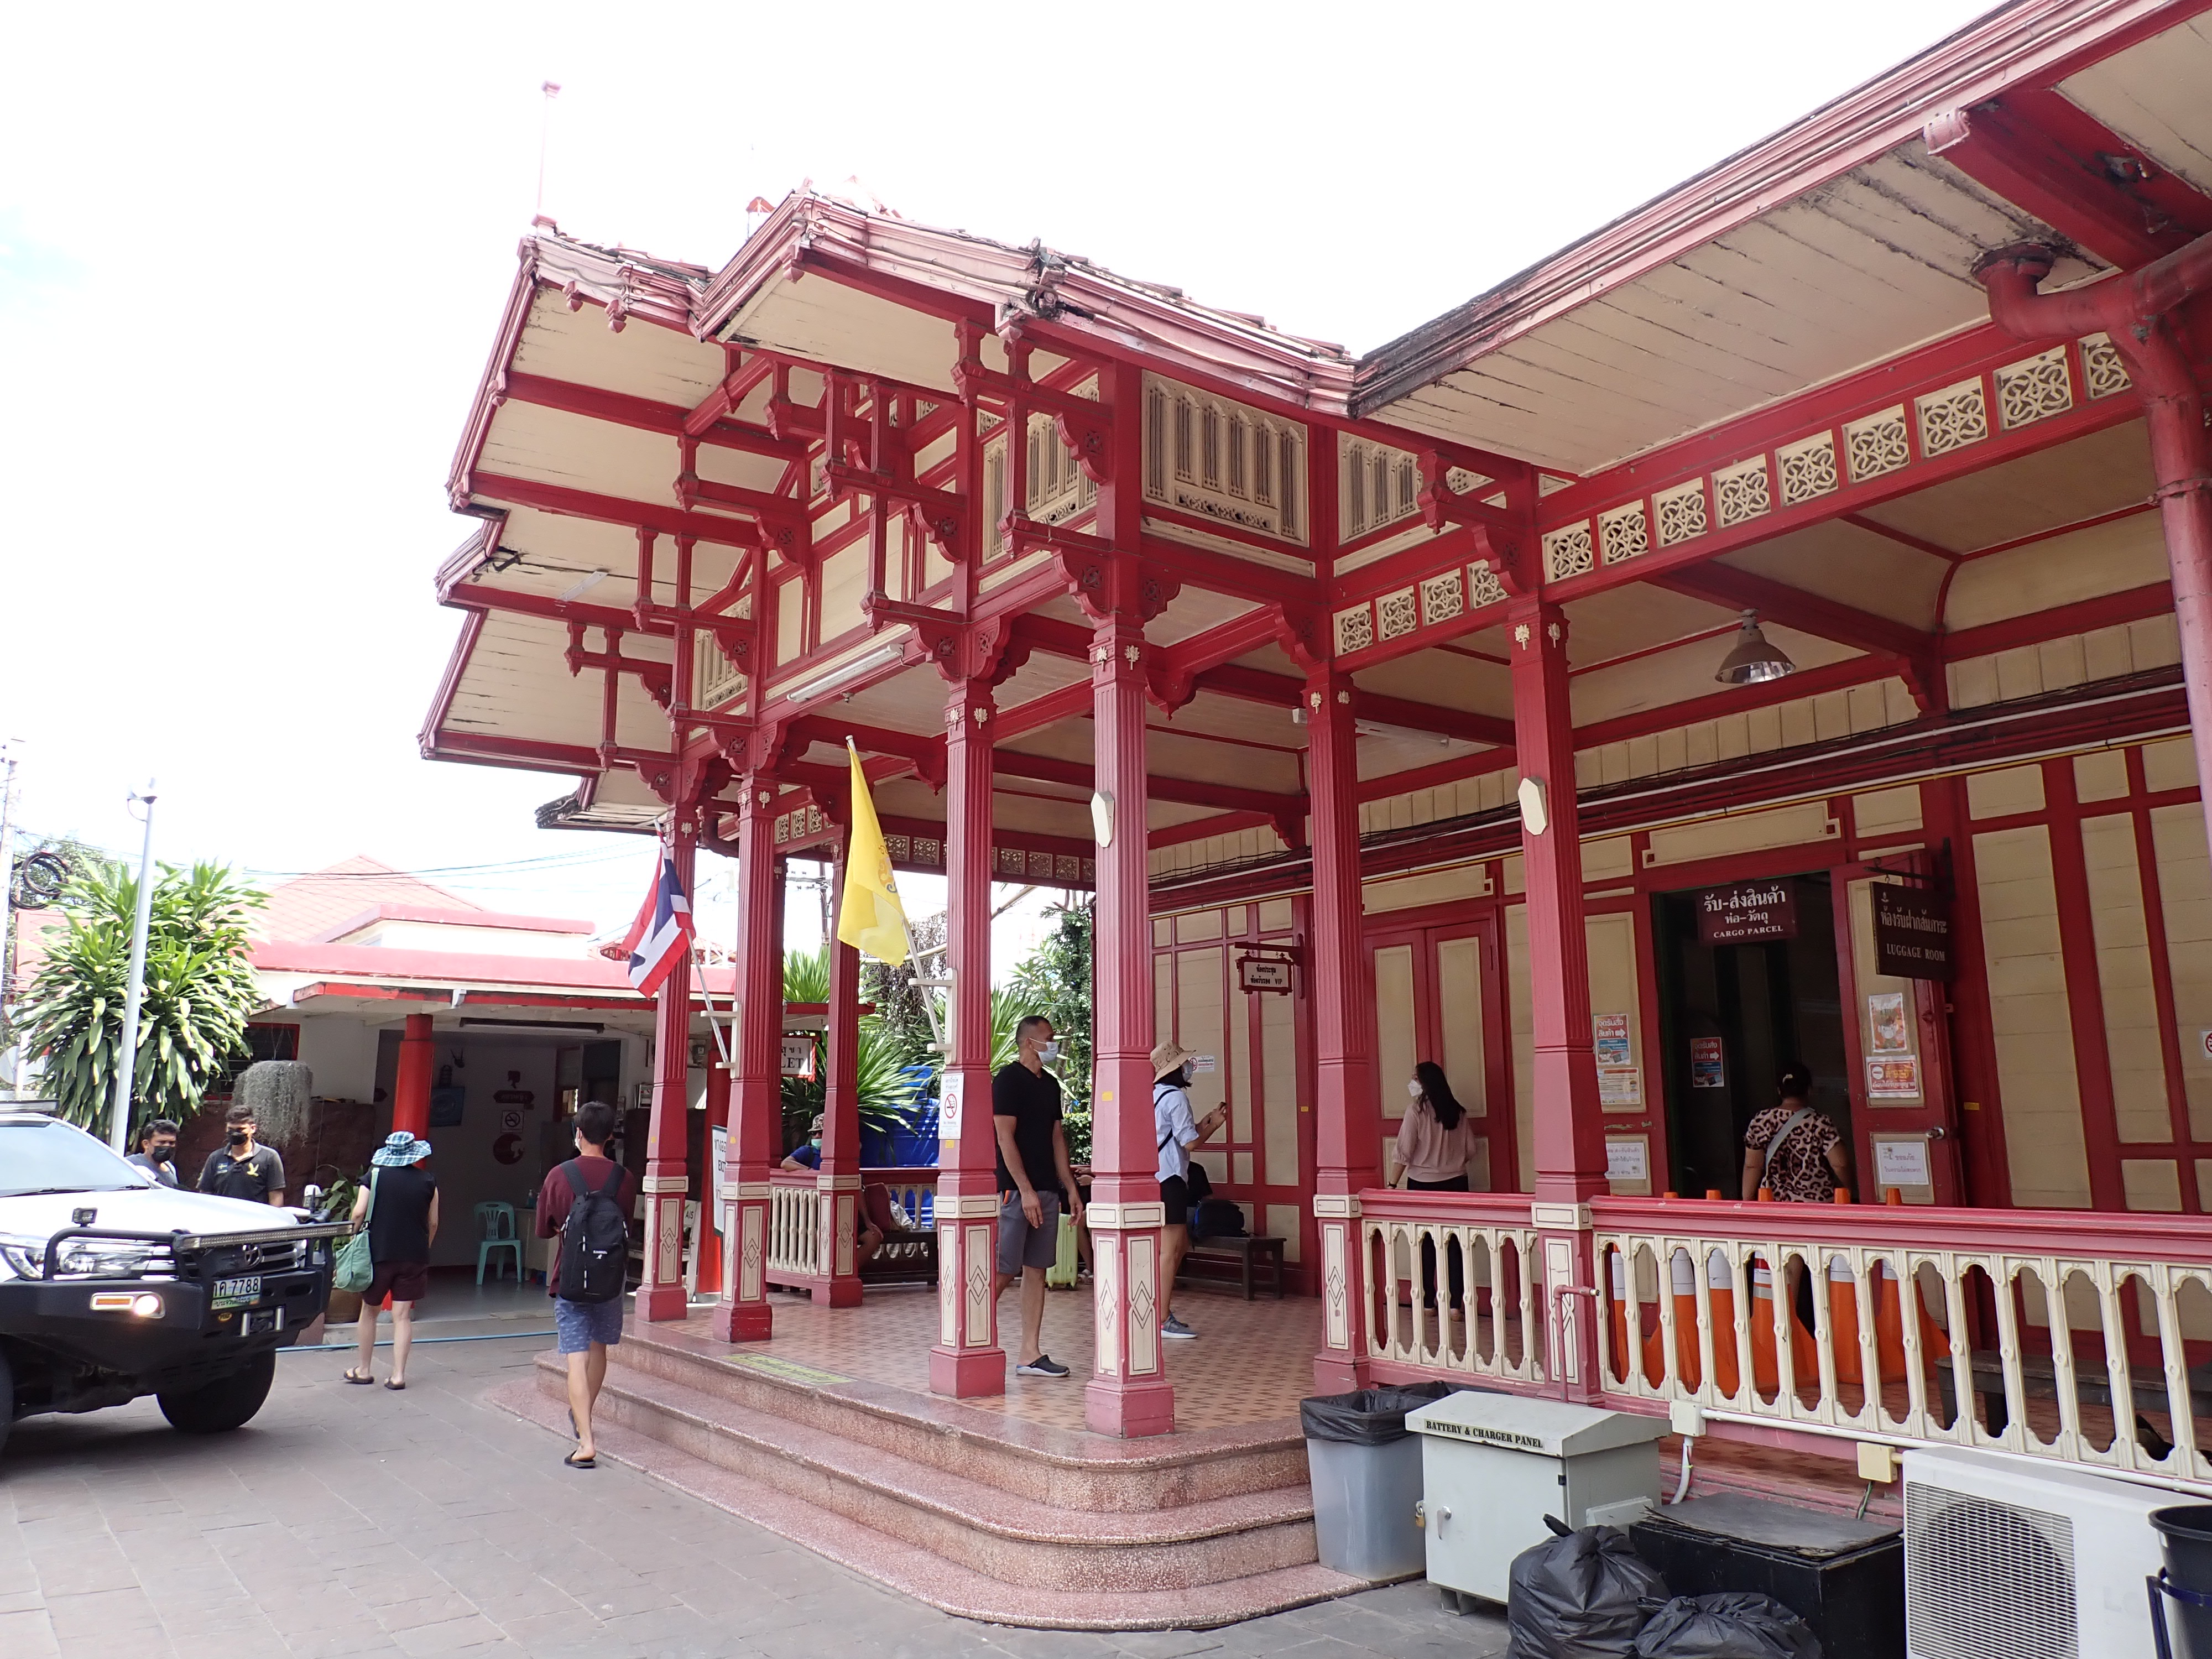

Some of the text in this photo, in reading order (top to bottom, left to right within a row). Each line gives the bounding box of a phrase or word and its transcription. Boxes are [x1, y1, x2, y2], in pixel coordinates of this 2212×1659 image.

[1704, 885, 1786, 912] รับ-ส่งสินค้า
[1881, 905, 1947, 933] ห้องรับฝากสัมภาระ
[1713, 925, 1783, 938] CARGO PARCEL
[1886, 943, 1945, 961] LUGGAGE ROOM
[685, 1211, 693, 1219] AIS
[232, 1278, 259, 1295] 7788
[1426, 1420, 1543, 1448] BATTERY & CHARGER PANEL
